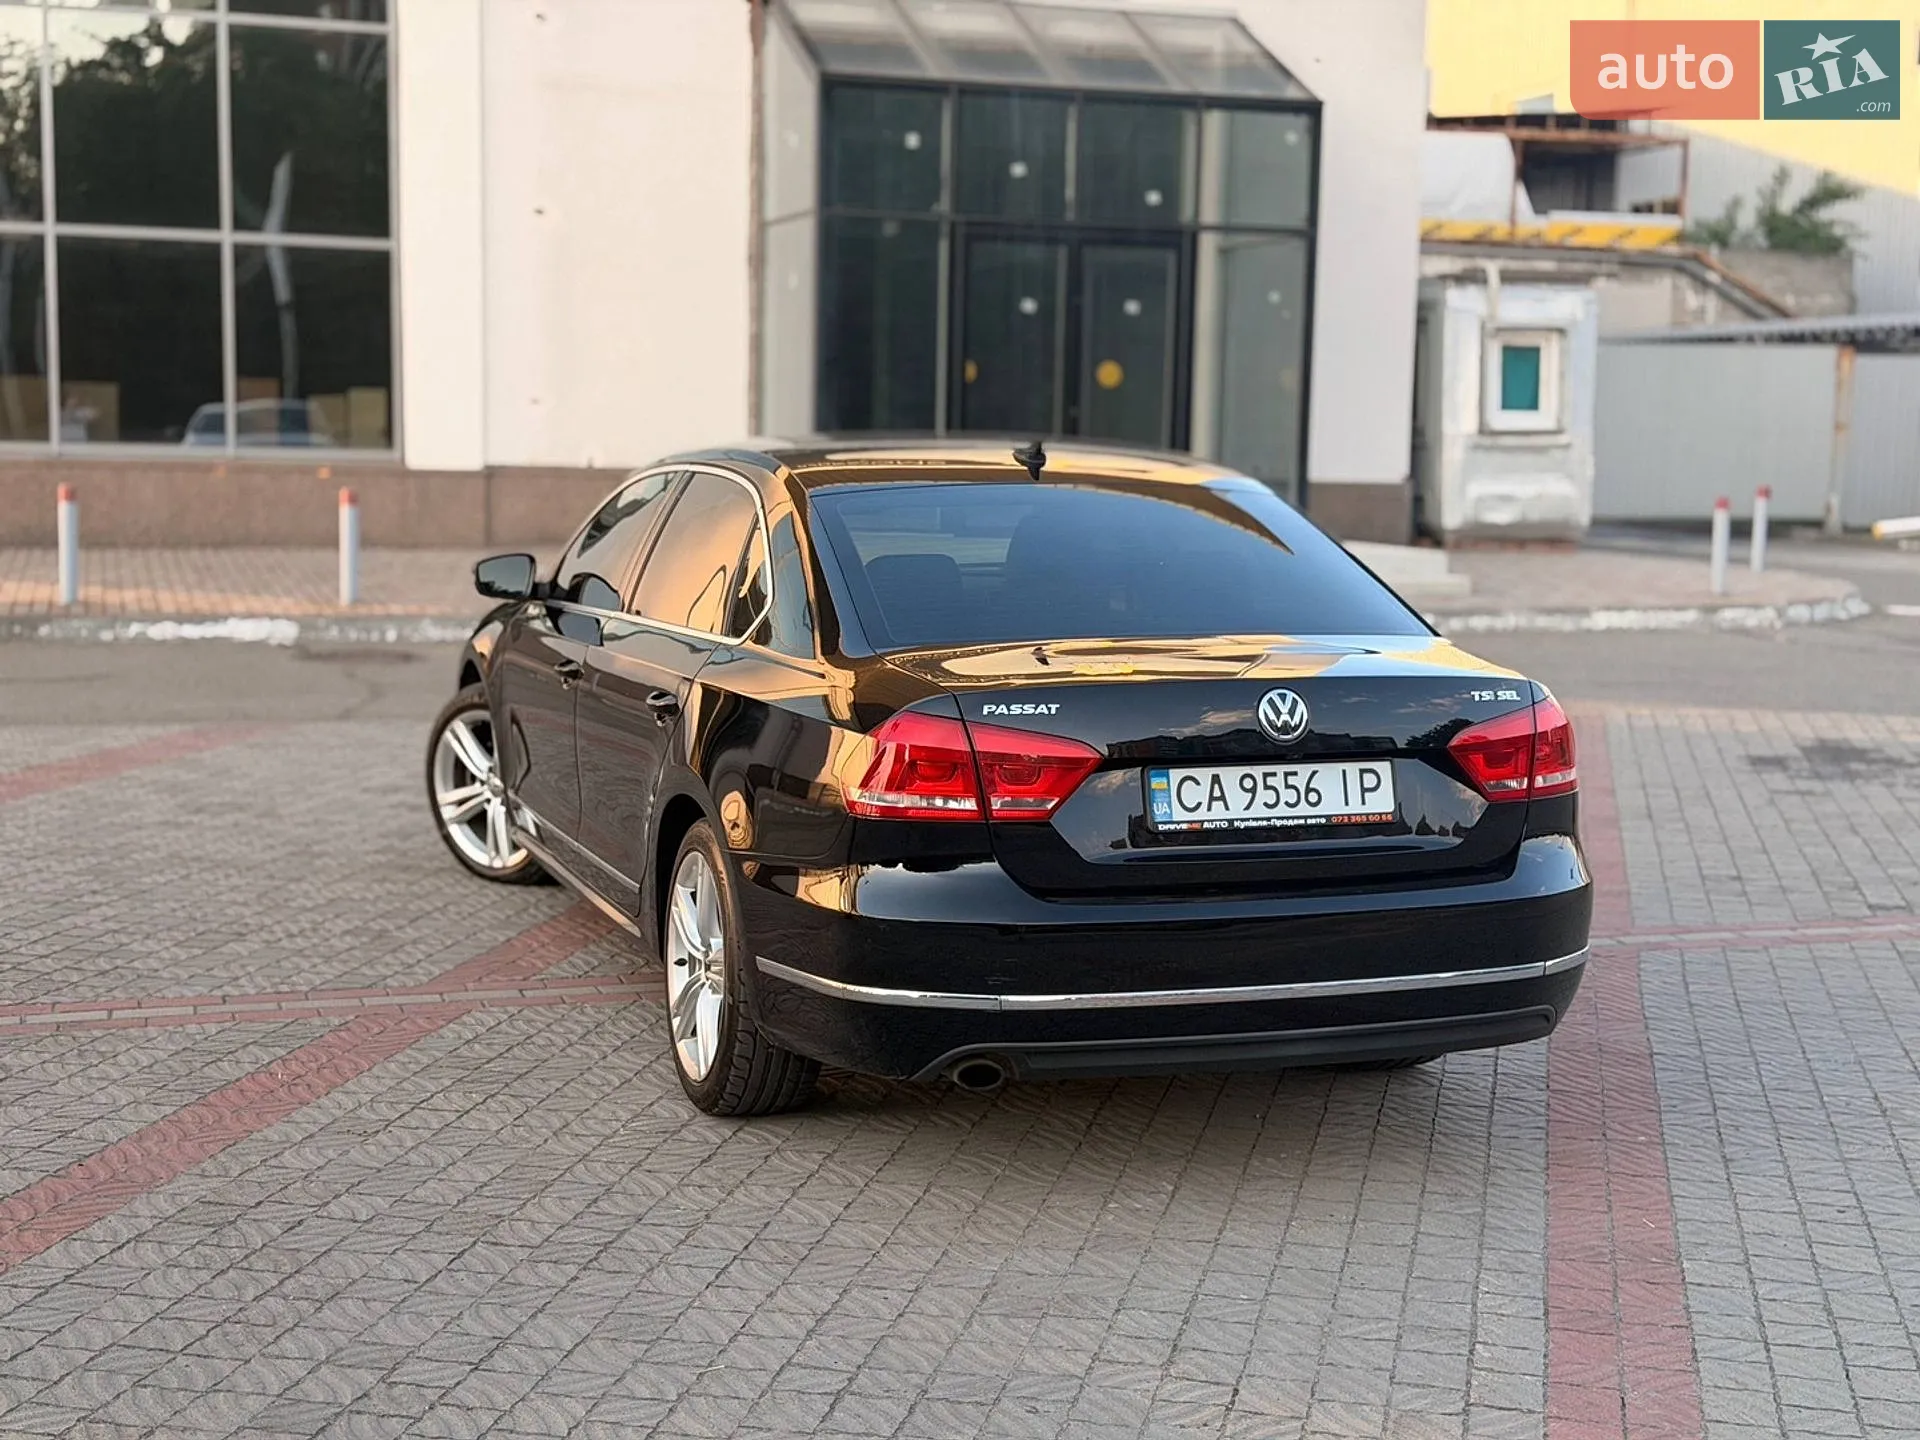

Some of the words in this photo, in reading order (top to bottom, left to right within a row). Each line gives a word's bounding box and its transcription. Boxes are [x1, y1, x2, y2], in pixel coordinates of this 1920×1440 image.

[1470, 690, 1495, 702] TSI
[982, 703, 1060, 716] PASSAT
[1175, 773, 1230, 813] CA
[1238, 769, 1323, 812] 9556
[1341, 767, 1382, 807] IP
[1153, 802, 1170, 816] UA
[1203, 820, 1228, 829] AUTO
[1306, 817, 1326, 825] авто
